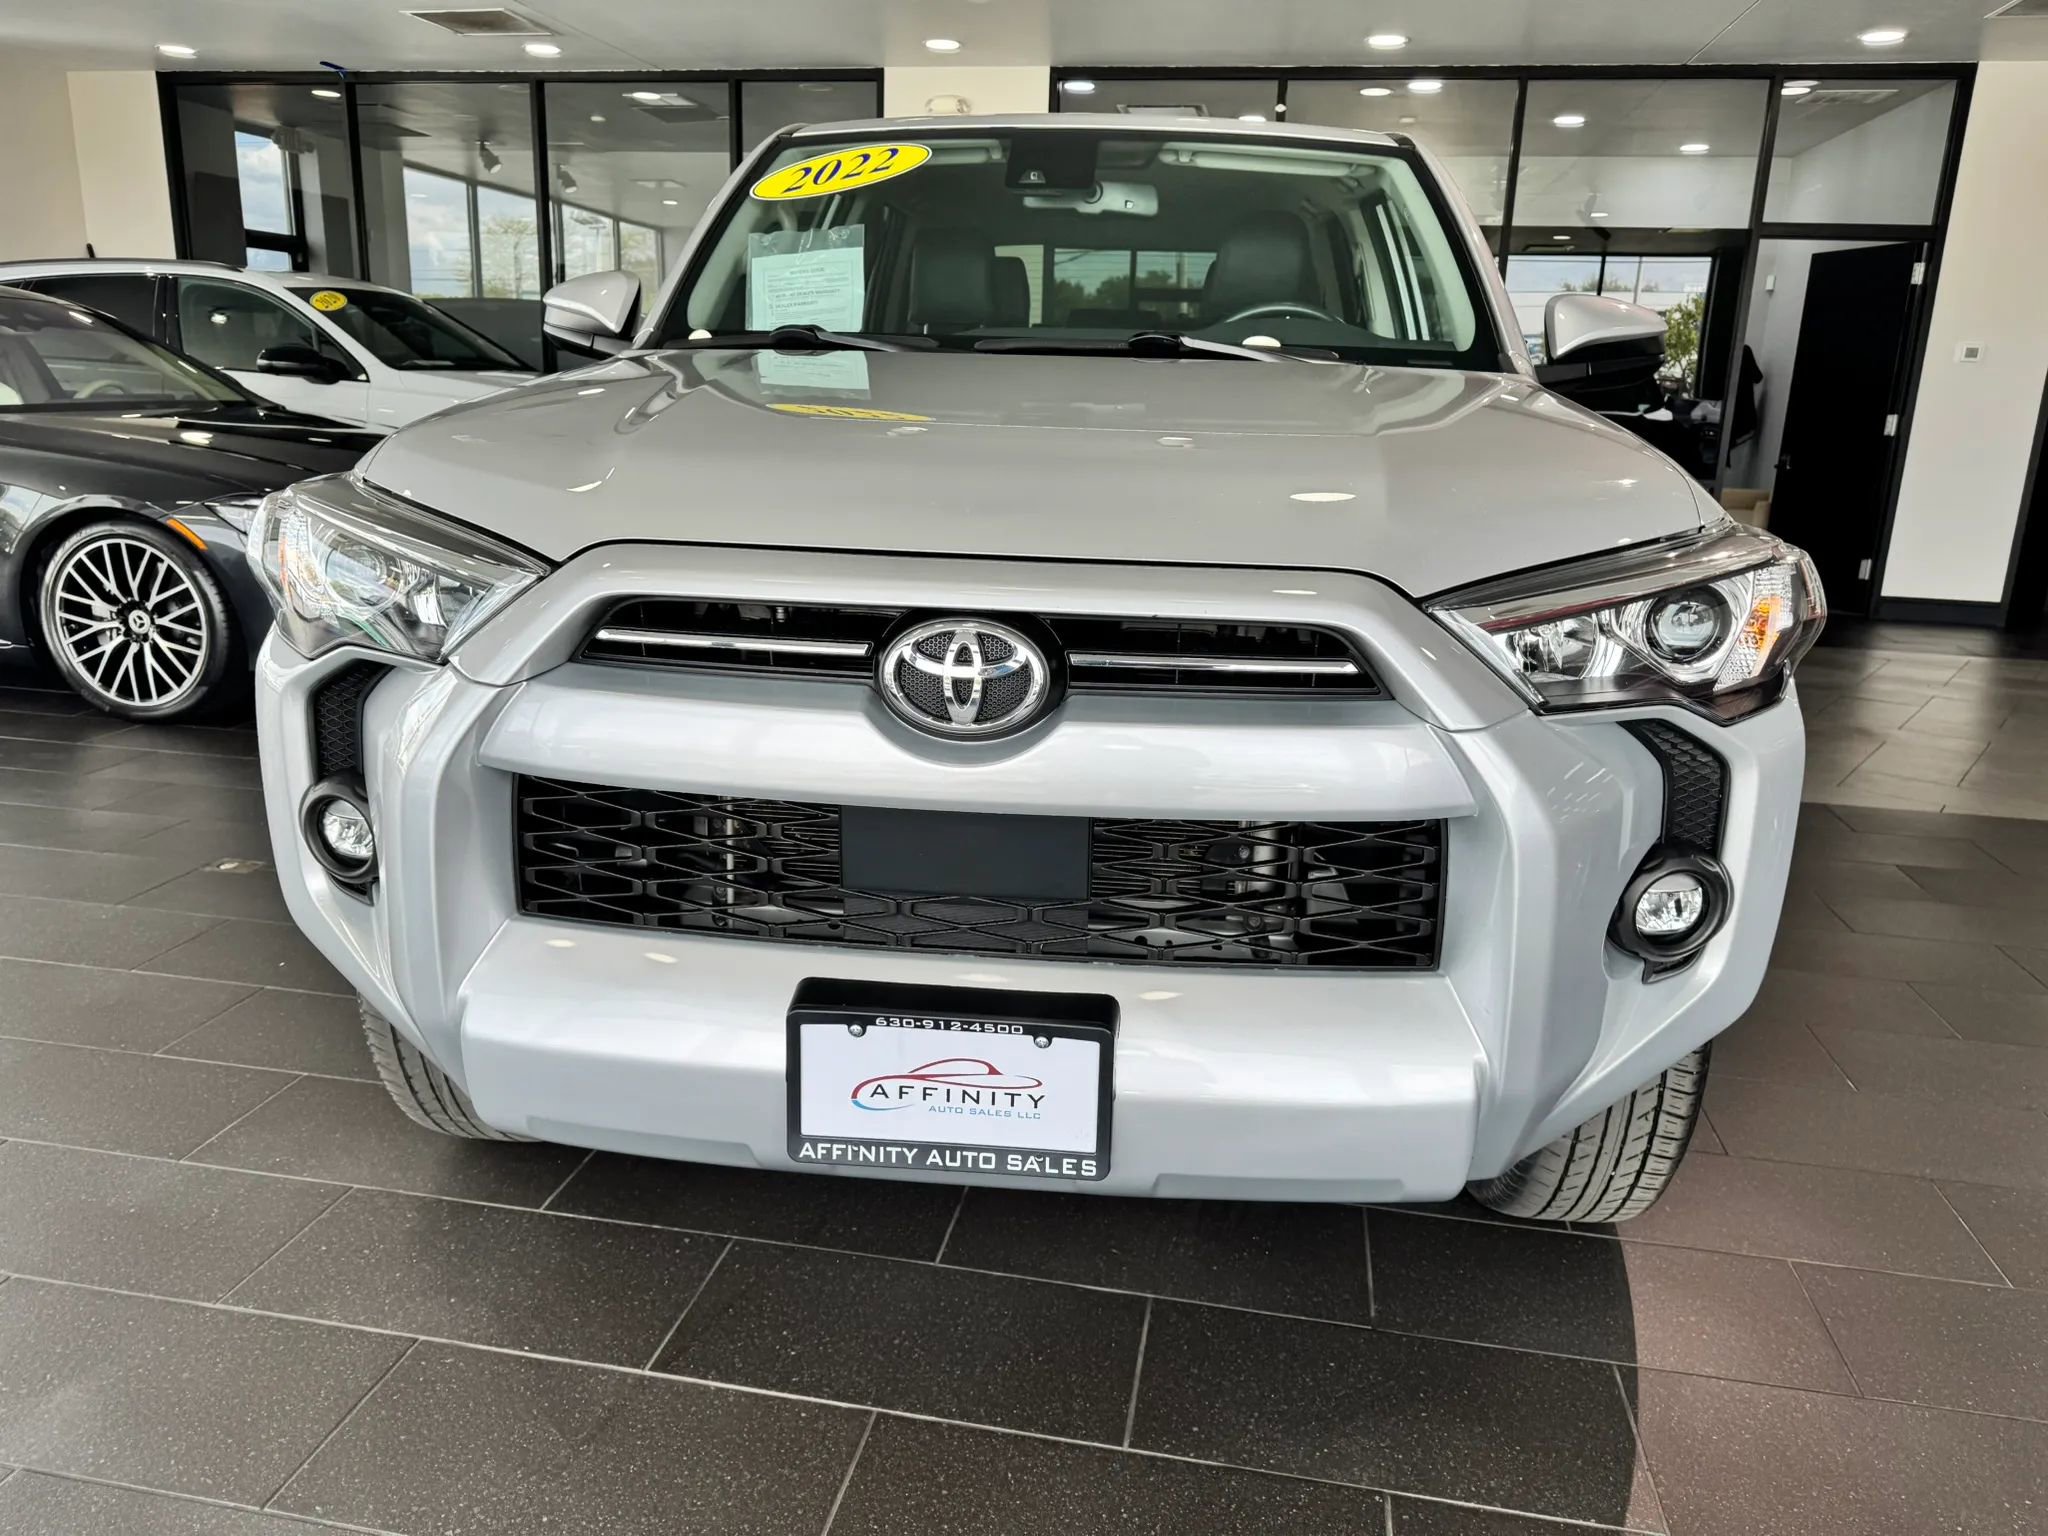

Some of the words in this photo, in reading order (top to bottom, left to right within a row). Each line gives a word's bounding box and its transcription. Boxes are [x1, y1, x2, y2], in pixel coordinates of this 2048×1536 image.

[782, 148, 899, 194] 2022
[875, 1016, 1024, 1035] 630-912-4500
[869, 1083, 1046, 1109] AFFINITY
[928, 1105, 964, 1115] AUTO
[969, 1107, 1012, 1118] SALES
[1017, 1111, 1042, 1120] LLC
[799, 1142, 918, 1165] AFFINITY
[926, 1149, 996, 1170] AUTO
[1006, 1154, 1098, 1177] SALES
